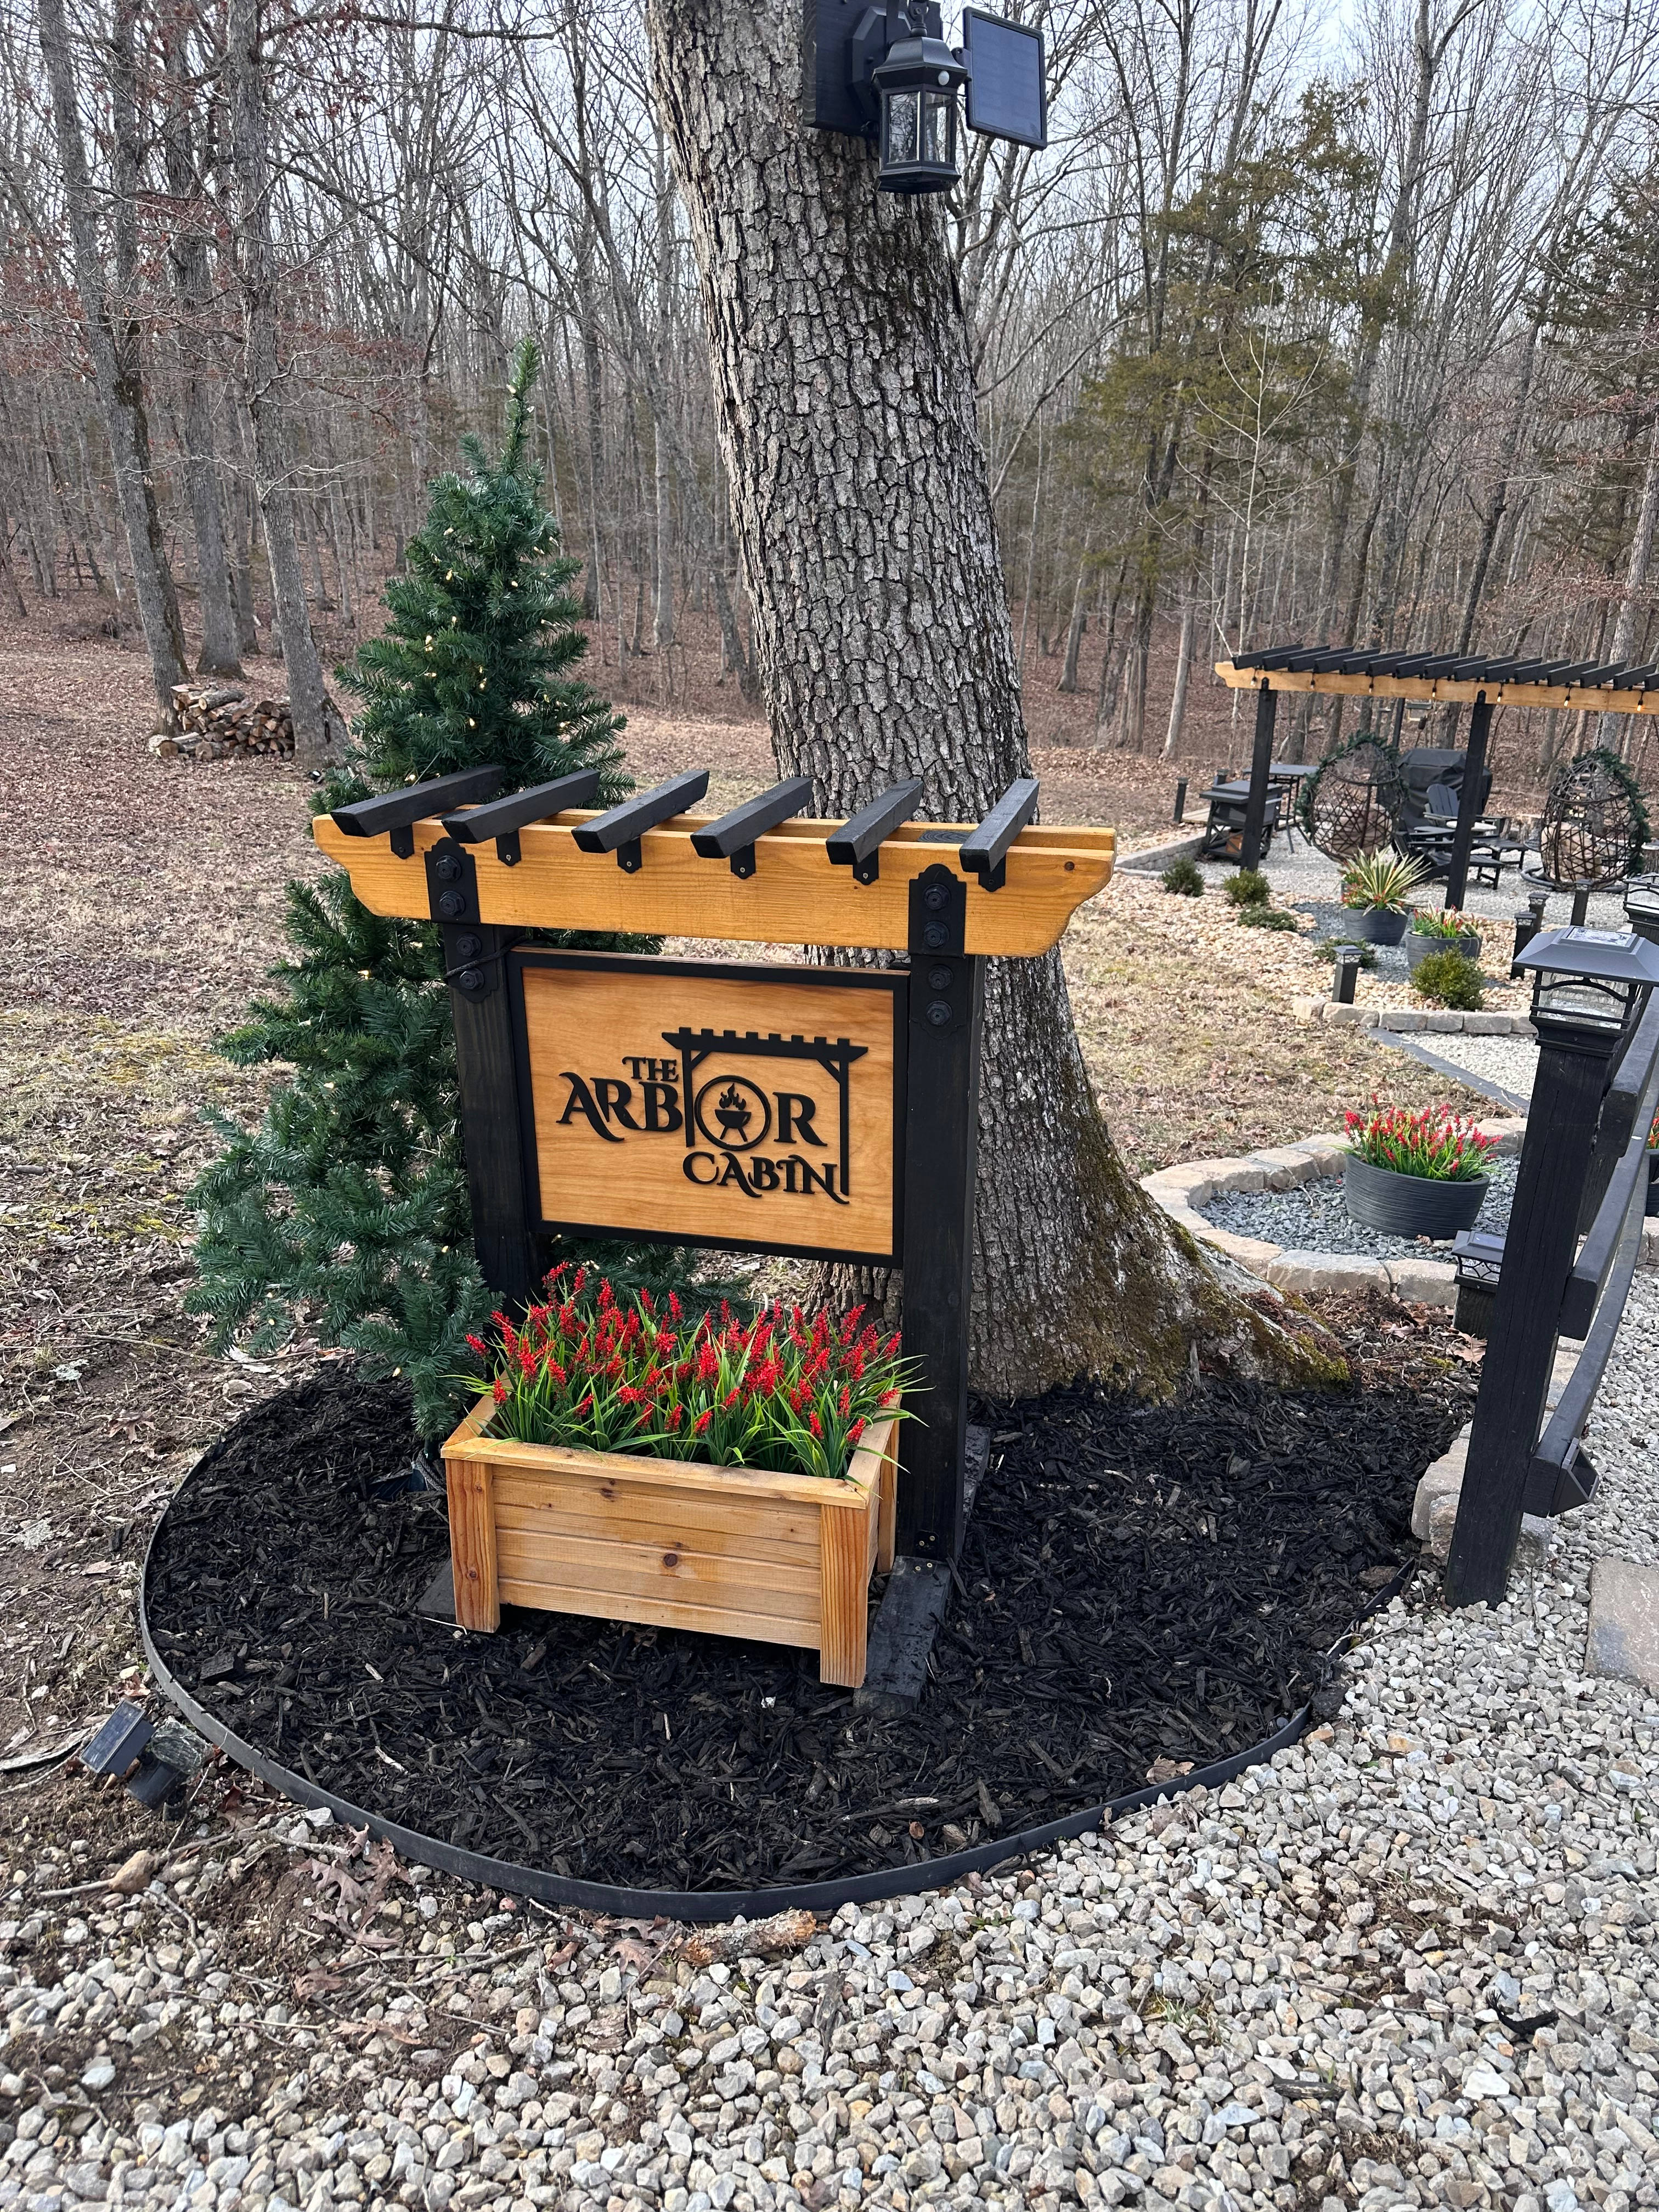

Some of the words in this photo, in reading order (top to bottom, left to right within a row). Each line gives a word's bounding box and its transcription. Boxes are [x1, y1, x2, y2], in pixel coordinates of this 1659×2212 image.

[622, 1056, 679, 1082] THE
[556, 1071, 827, 1151] ARBOR
[682, 1152, 850, 1204] CABIN
